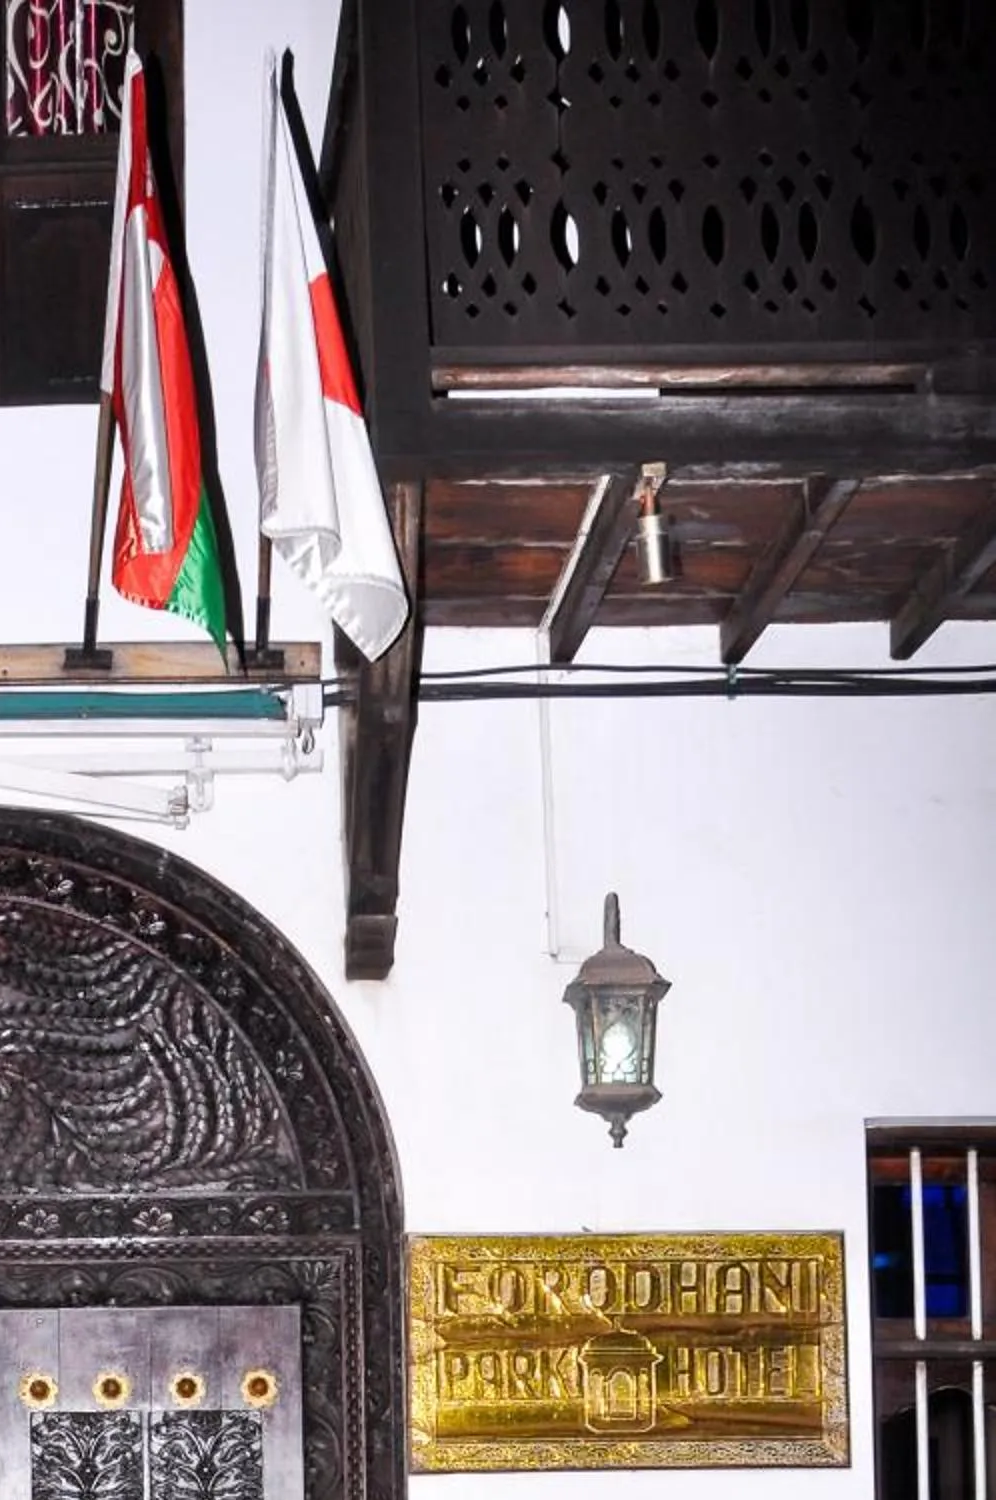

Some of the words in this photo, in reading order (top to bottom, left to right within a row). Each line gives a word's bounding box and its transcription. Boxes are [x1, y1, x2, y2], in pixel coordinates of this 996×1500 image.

[437, 1259, 821, 1315] FORODHANI
[438, 1347, 583, 1399] PARK
[668, 1344, 821, 1399] HOTEL
